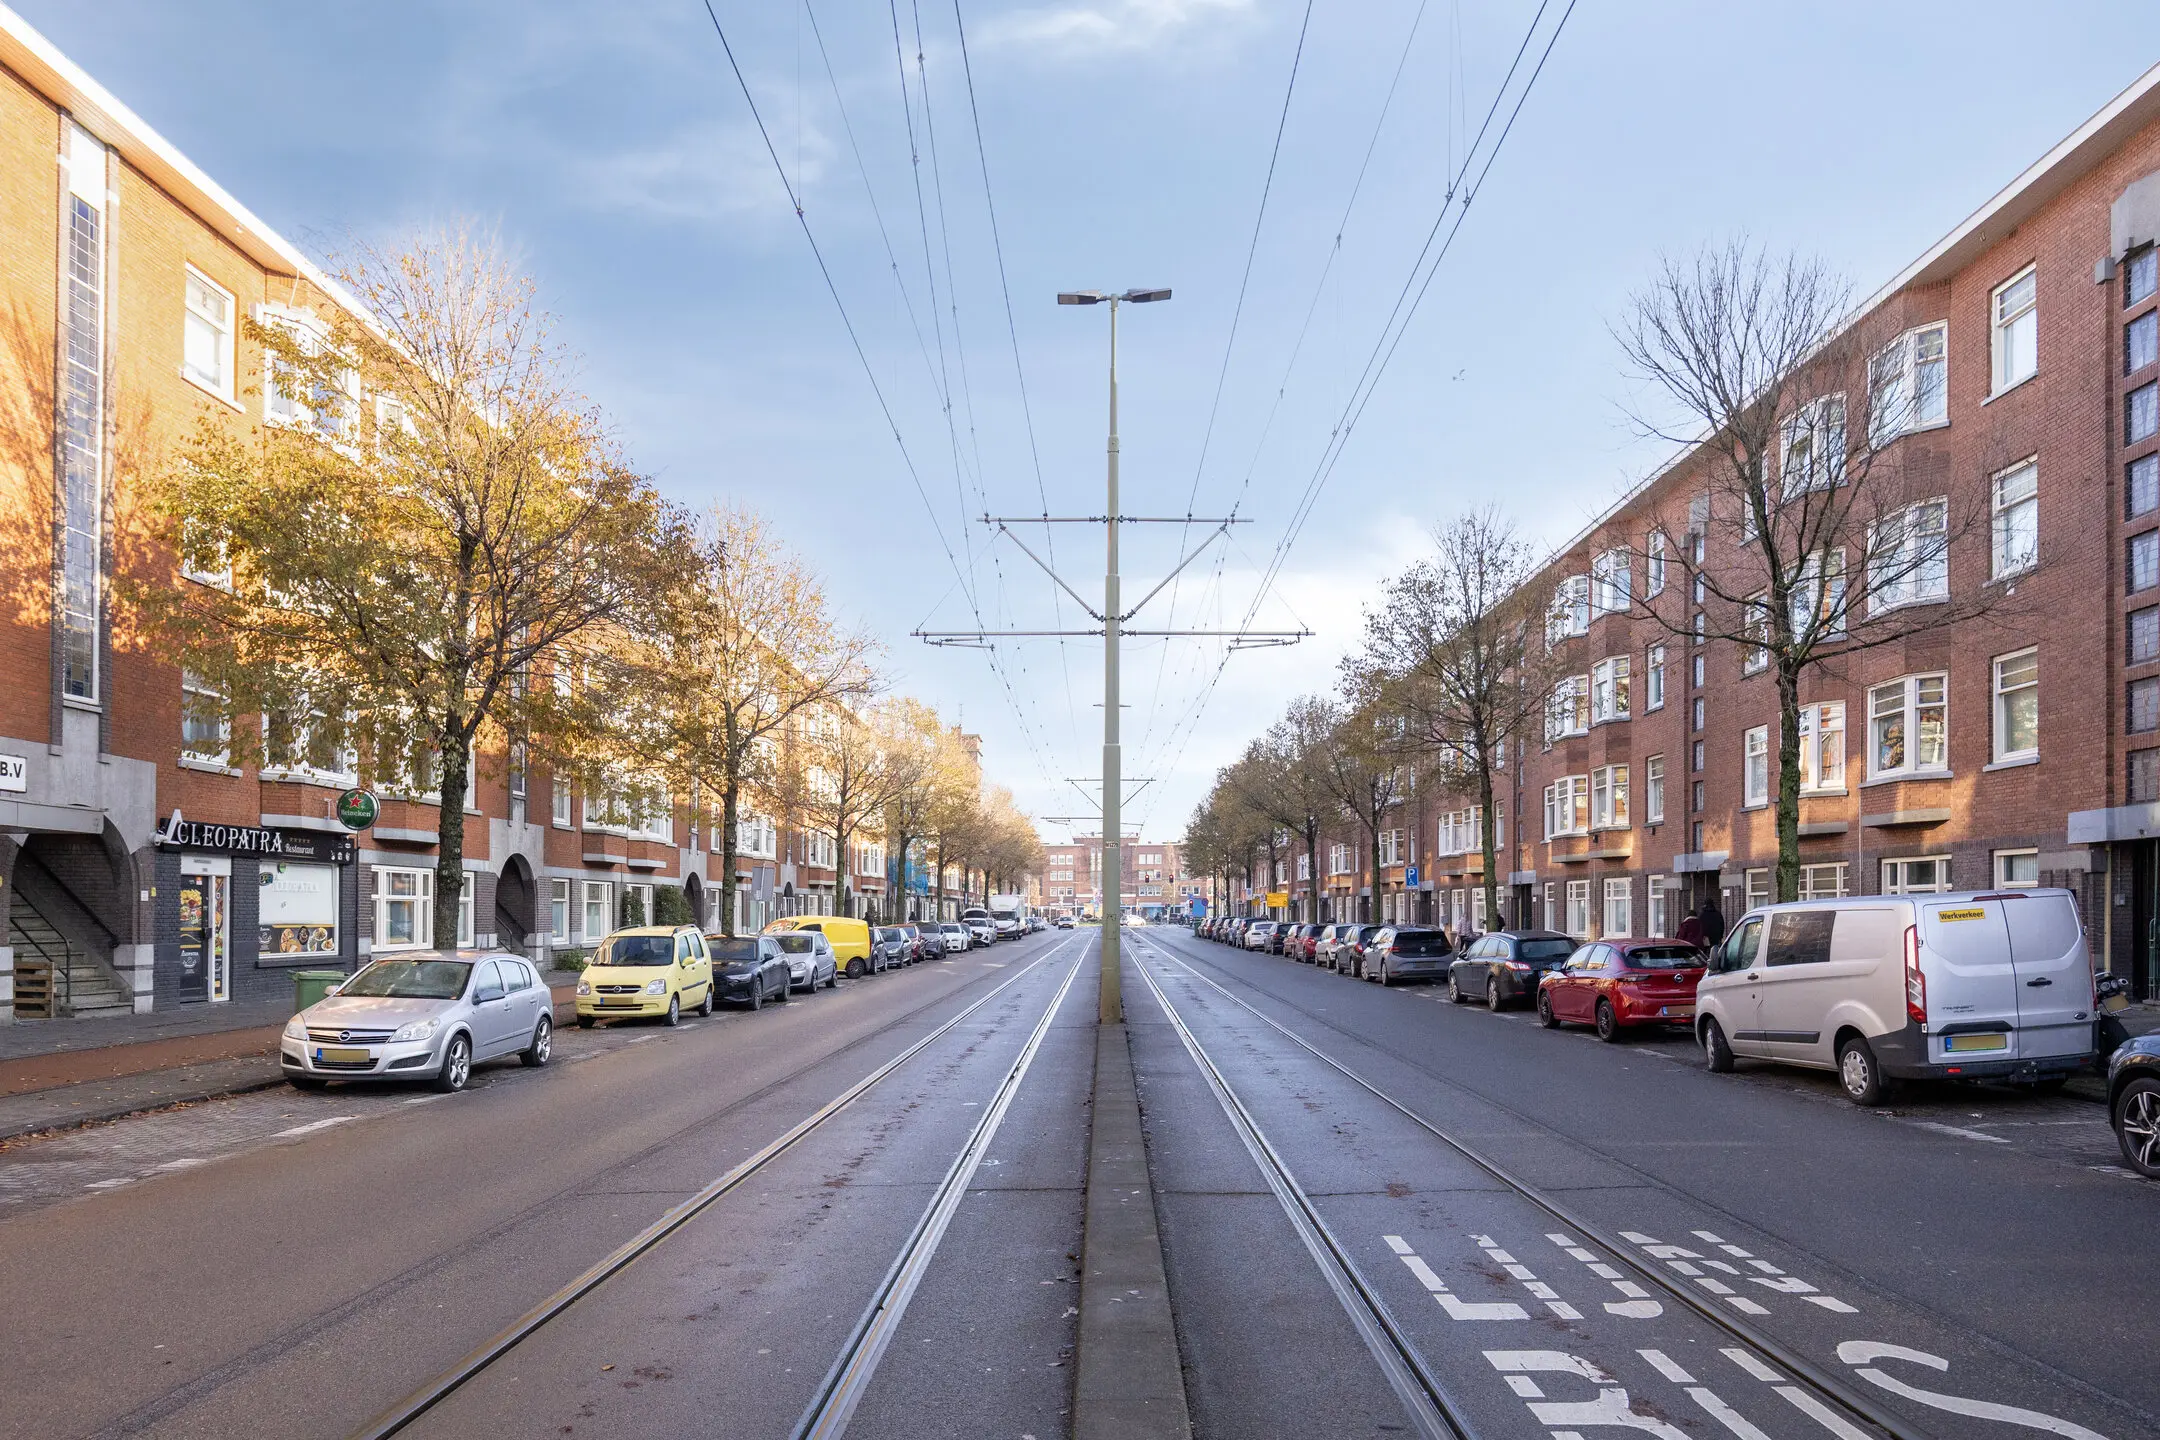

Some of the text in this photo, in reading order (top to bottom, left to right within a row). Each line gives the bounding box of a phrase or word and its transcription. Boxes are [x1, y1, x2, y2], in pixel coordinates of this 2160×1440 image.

[177, 822, 283, 852] CLEOPATRA
[285, 843, 314, 855] Restaurant
[1382, 1231, 1860, 1321] LIJN
